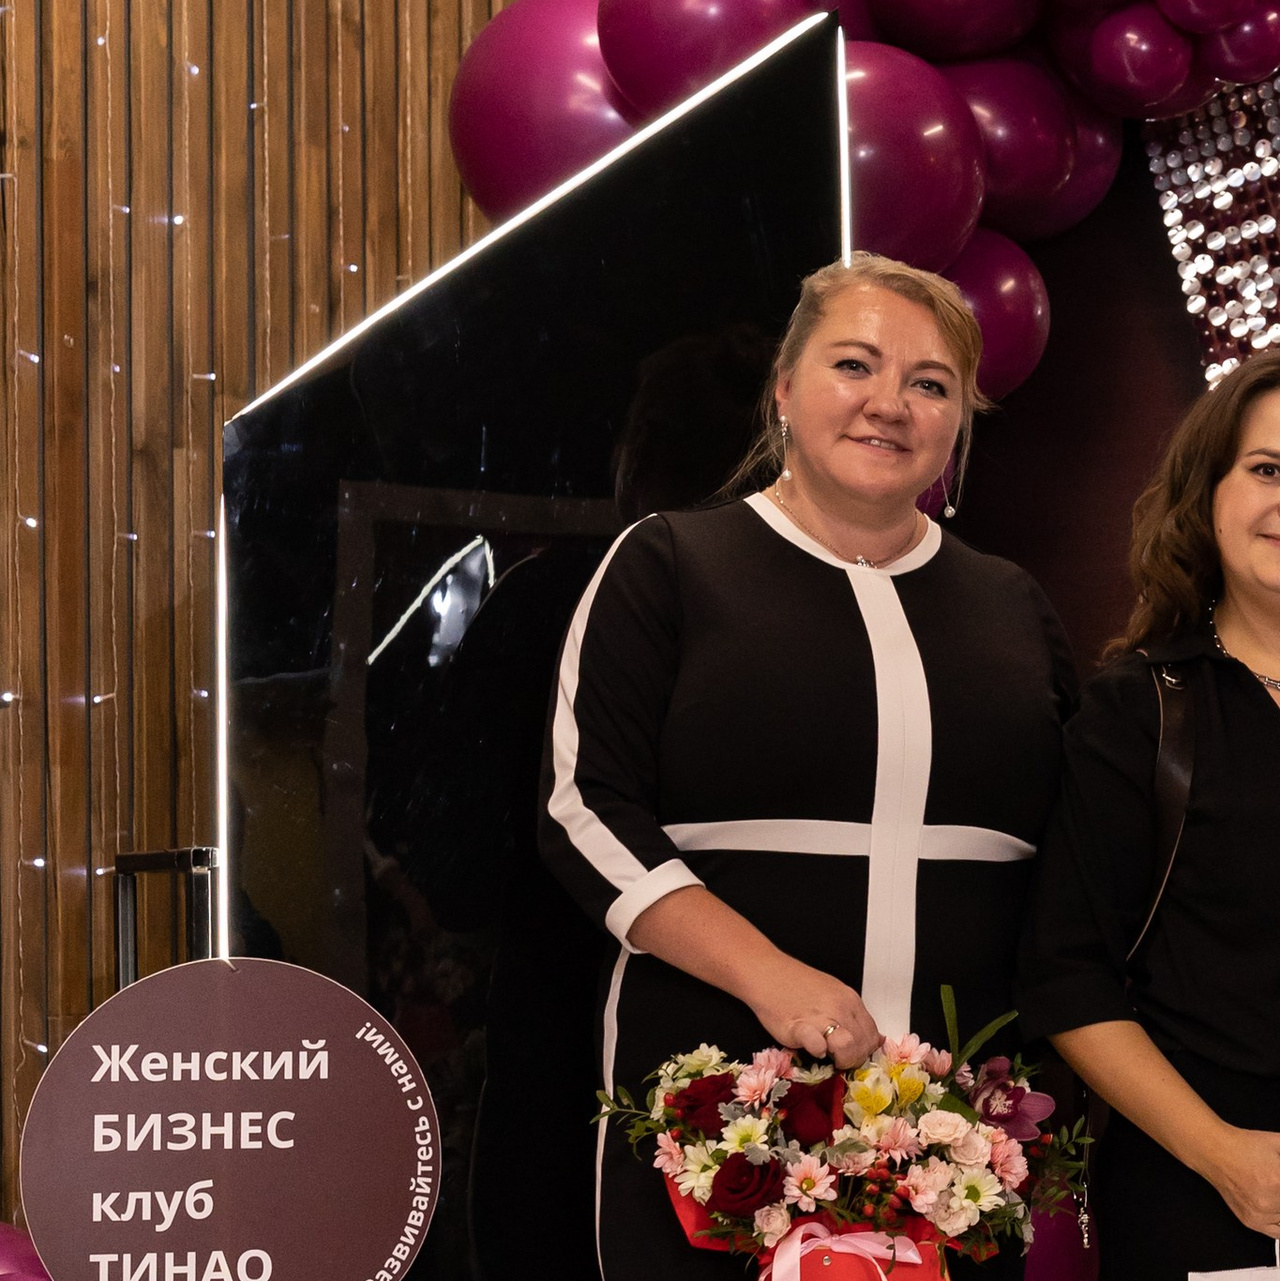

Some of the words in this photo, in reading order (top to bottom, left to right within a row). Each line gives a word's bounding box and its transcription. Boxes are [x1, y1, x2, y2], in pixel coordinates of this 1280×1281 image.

[90, 1039, 329, 1082] Женский
[355, 1022, 417, 1093] нами!
[407, 1095, 424, 1111] с
[93, 1111, 296, 1152] БИЗНЕС
[92, 1179, 215, 1232] клуб
